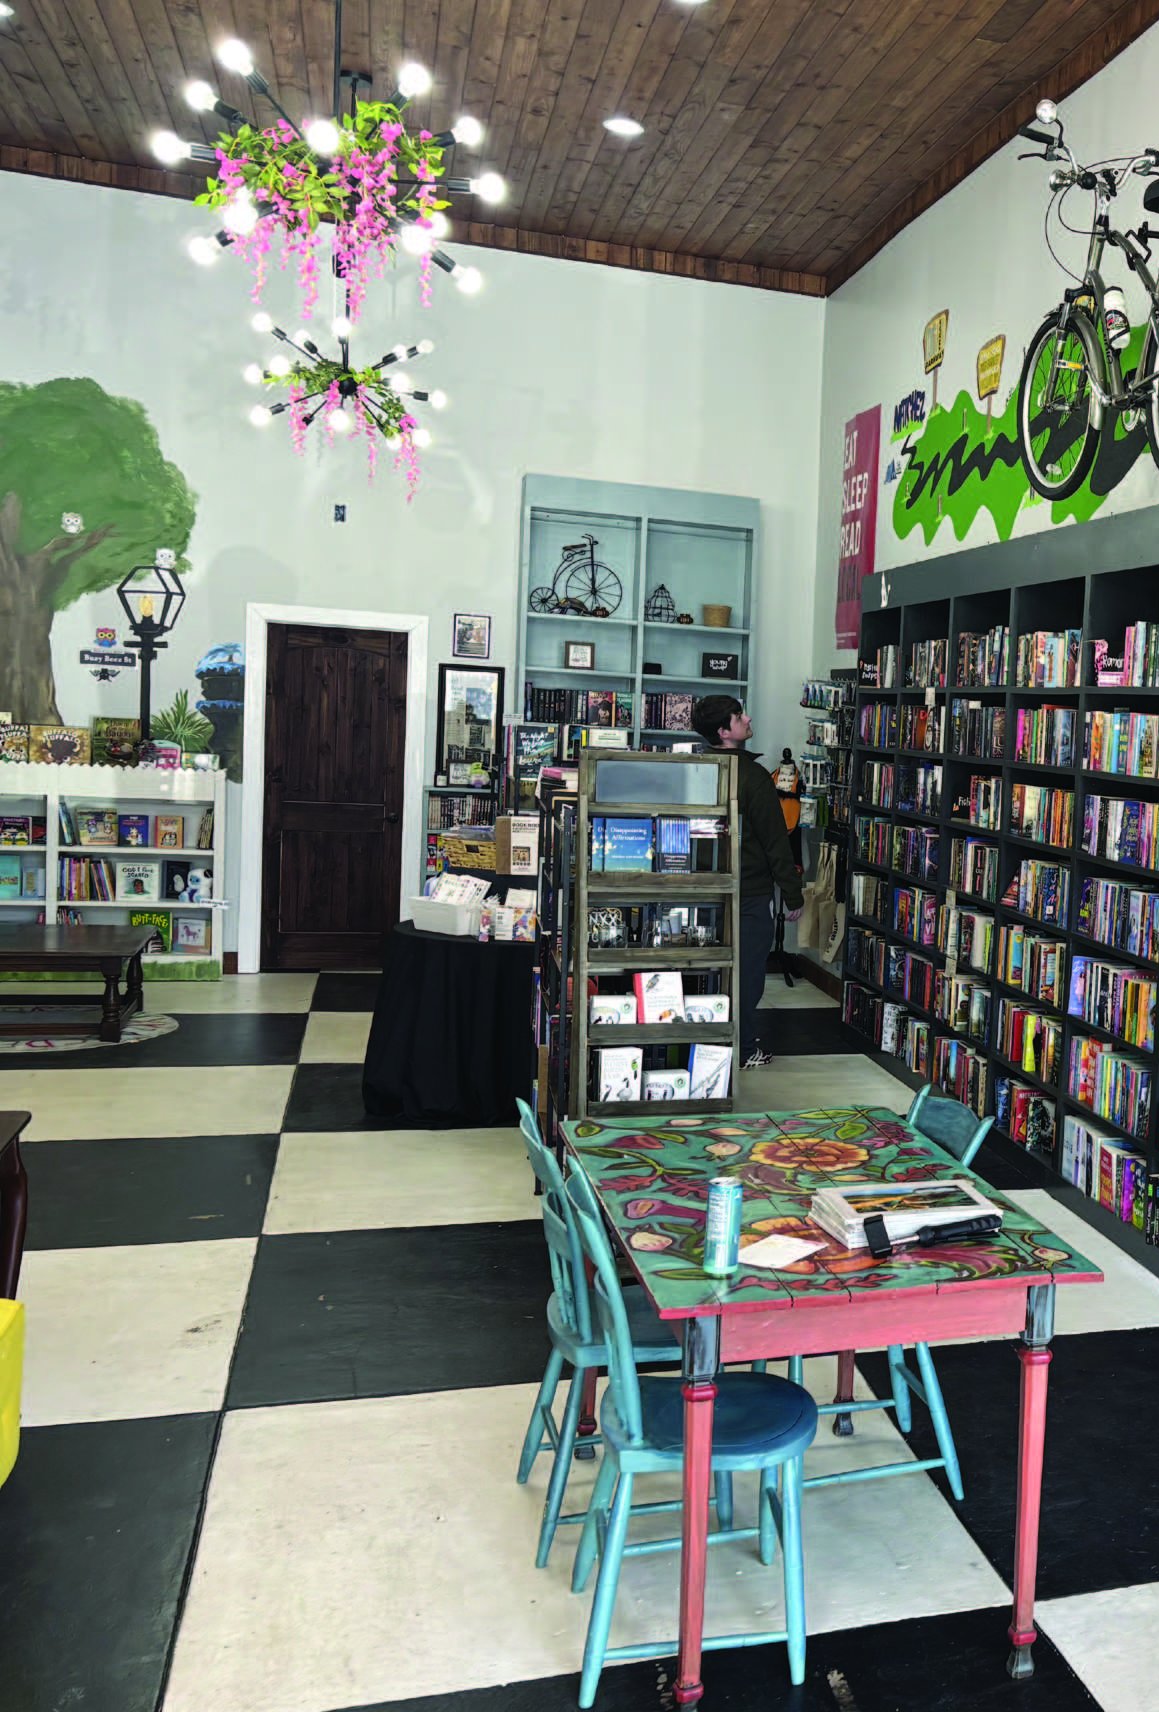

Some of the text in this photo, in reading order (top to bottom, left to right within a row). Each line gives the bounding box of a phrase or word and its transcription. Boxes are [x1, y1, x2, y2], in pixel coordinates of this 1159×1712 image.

[843, 430, 859, 471] EAT
[841, 471, 869, 514] SLEEP
[839, 519, 862, 558] READ
